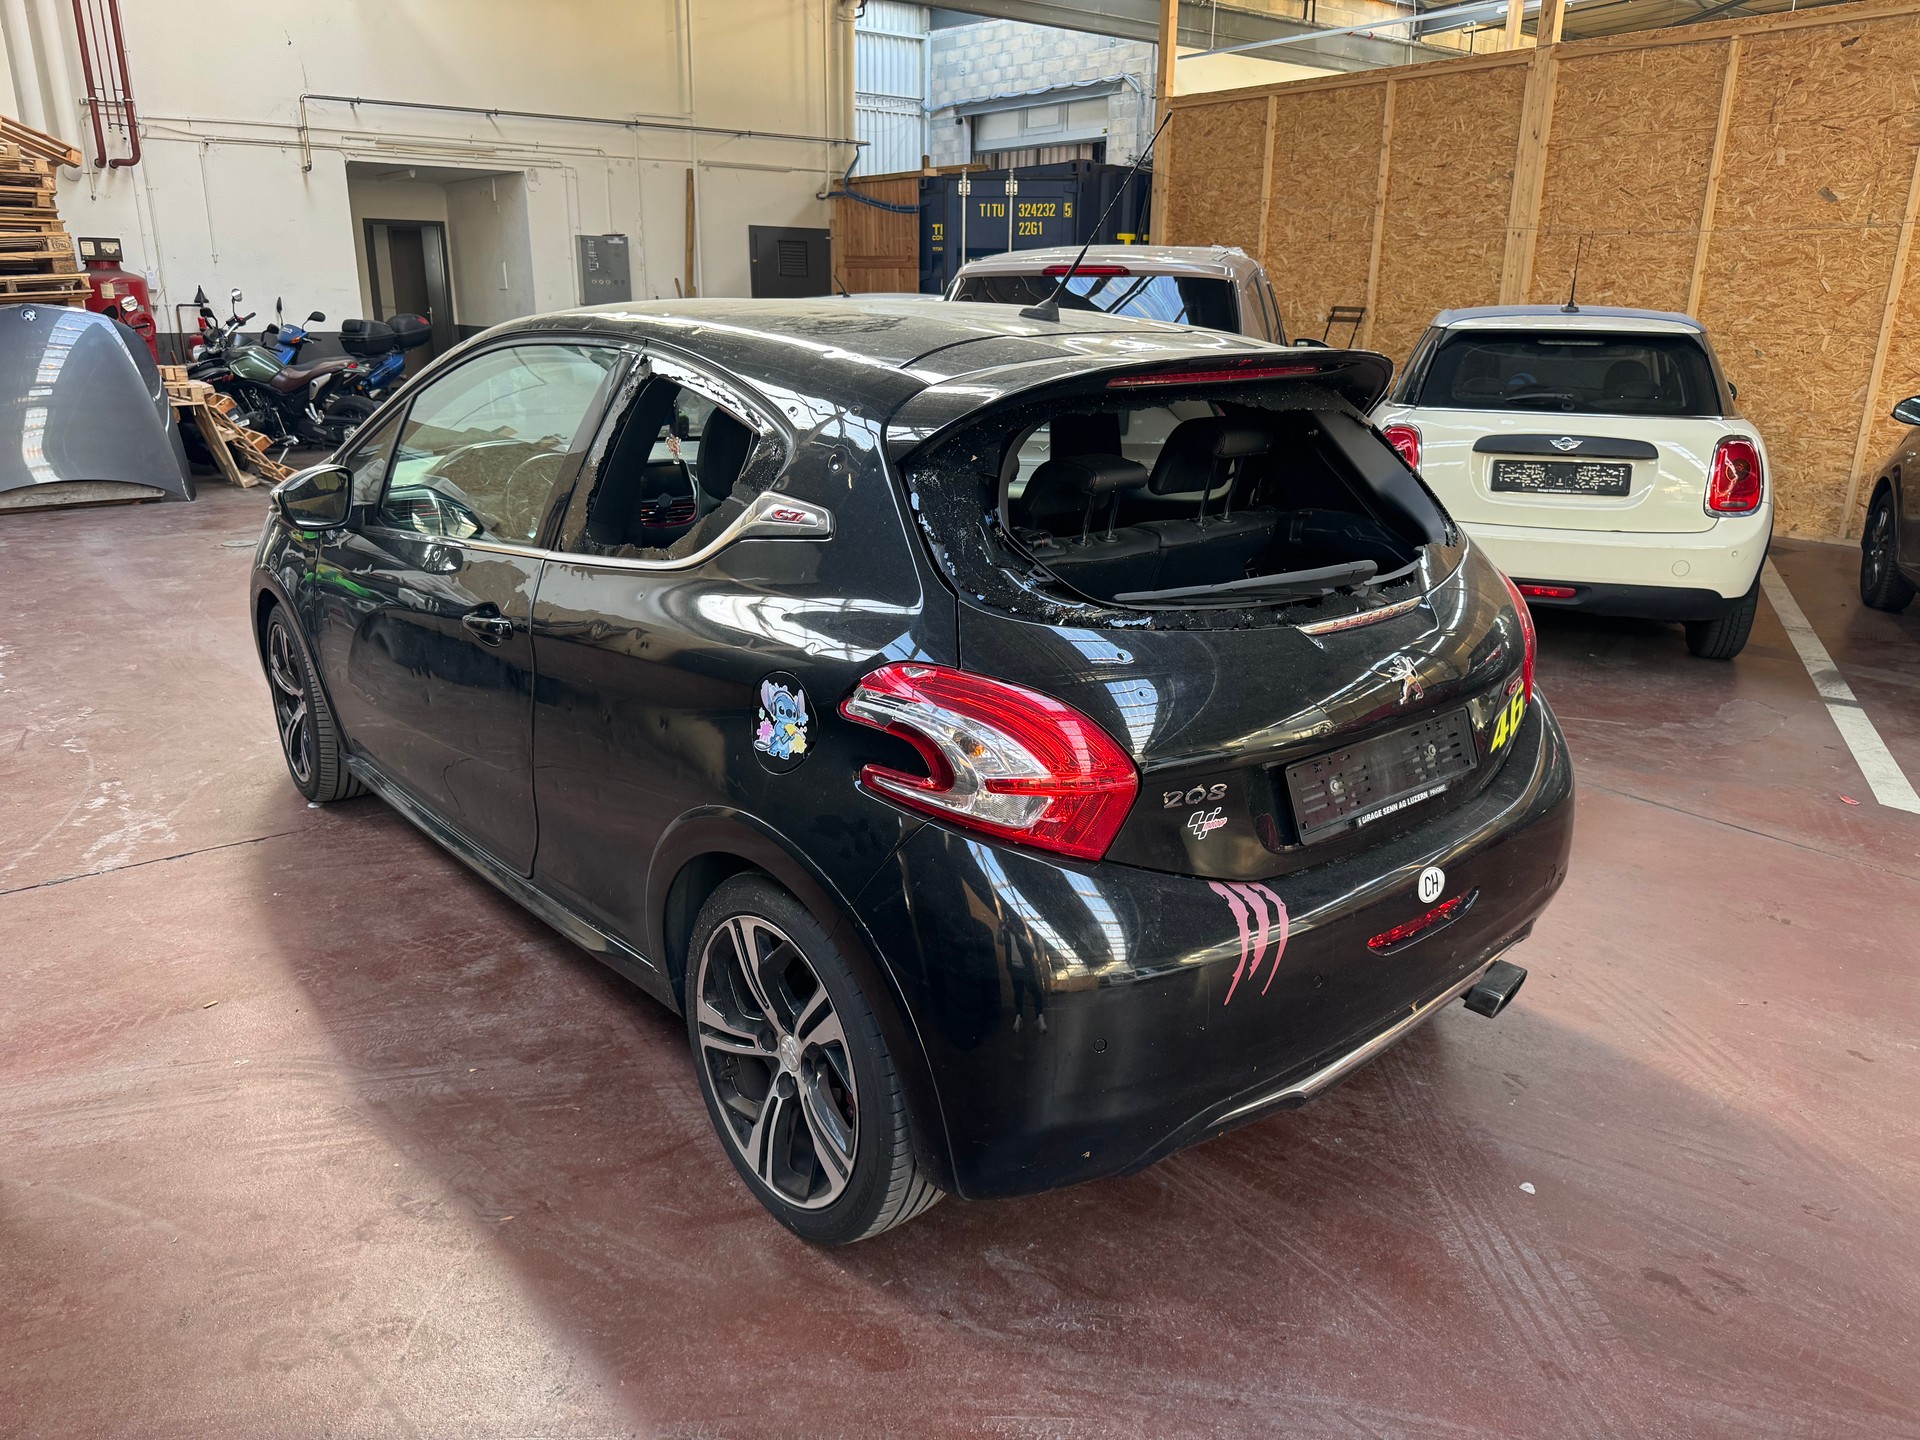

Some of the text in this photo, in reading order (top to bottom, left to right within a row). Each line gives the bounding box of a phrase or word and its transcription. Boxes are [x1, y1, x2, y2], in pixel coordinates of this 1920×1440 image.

[979, 203, 1072, 217] TITU 324232 5
[1018, 222, 1043, 235] 22G1
[1333, 605, 1407, 630] PEUGEOT
[1490, 681, 1524, 753] 46
[1163, 783, 1228, 809] 208
[1361, 809, 1383, 825] GARAGE
[1382, 803, 1399, 816] SENN
[1399, 799, 1408, 810] AG
[1406, 790, 1429, 806] LUZERN
[1425, 872, 1438, 897] CH
